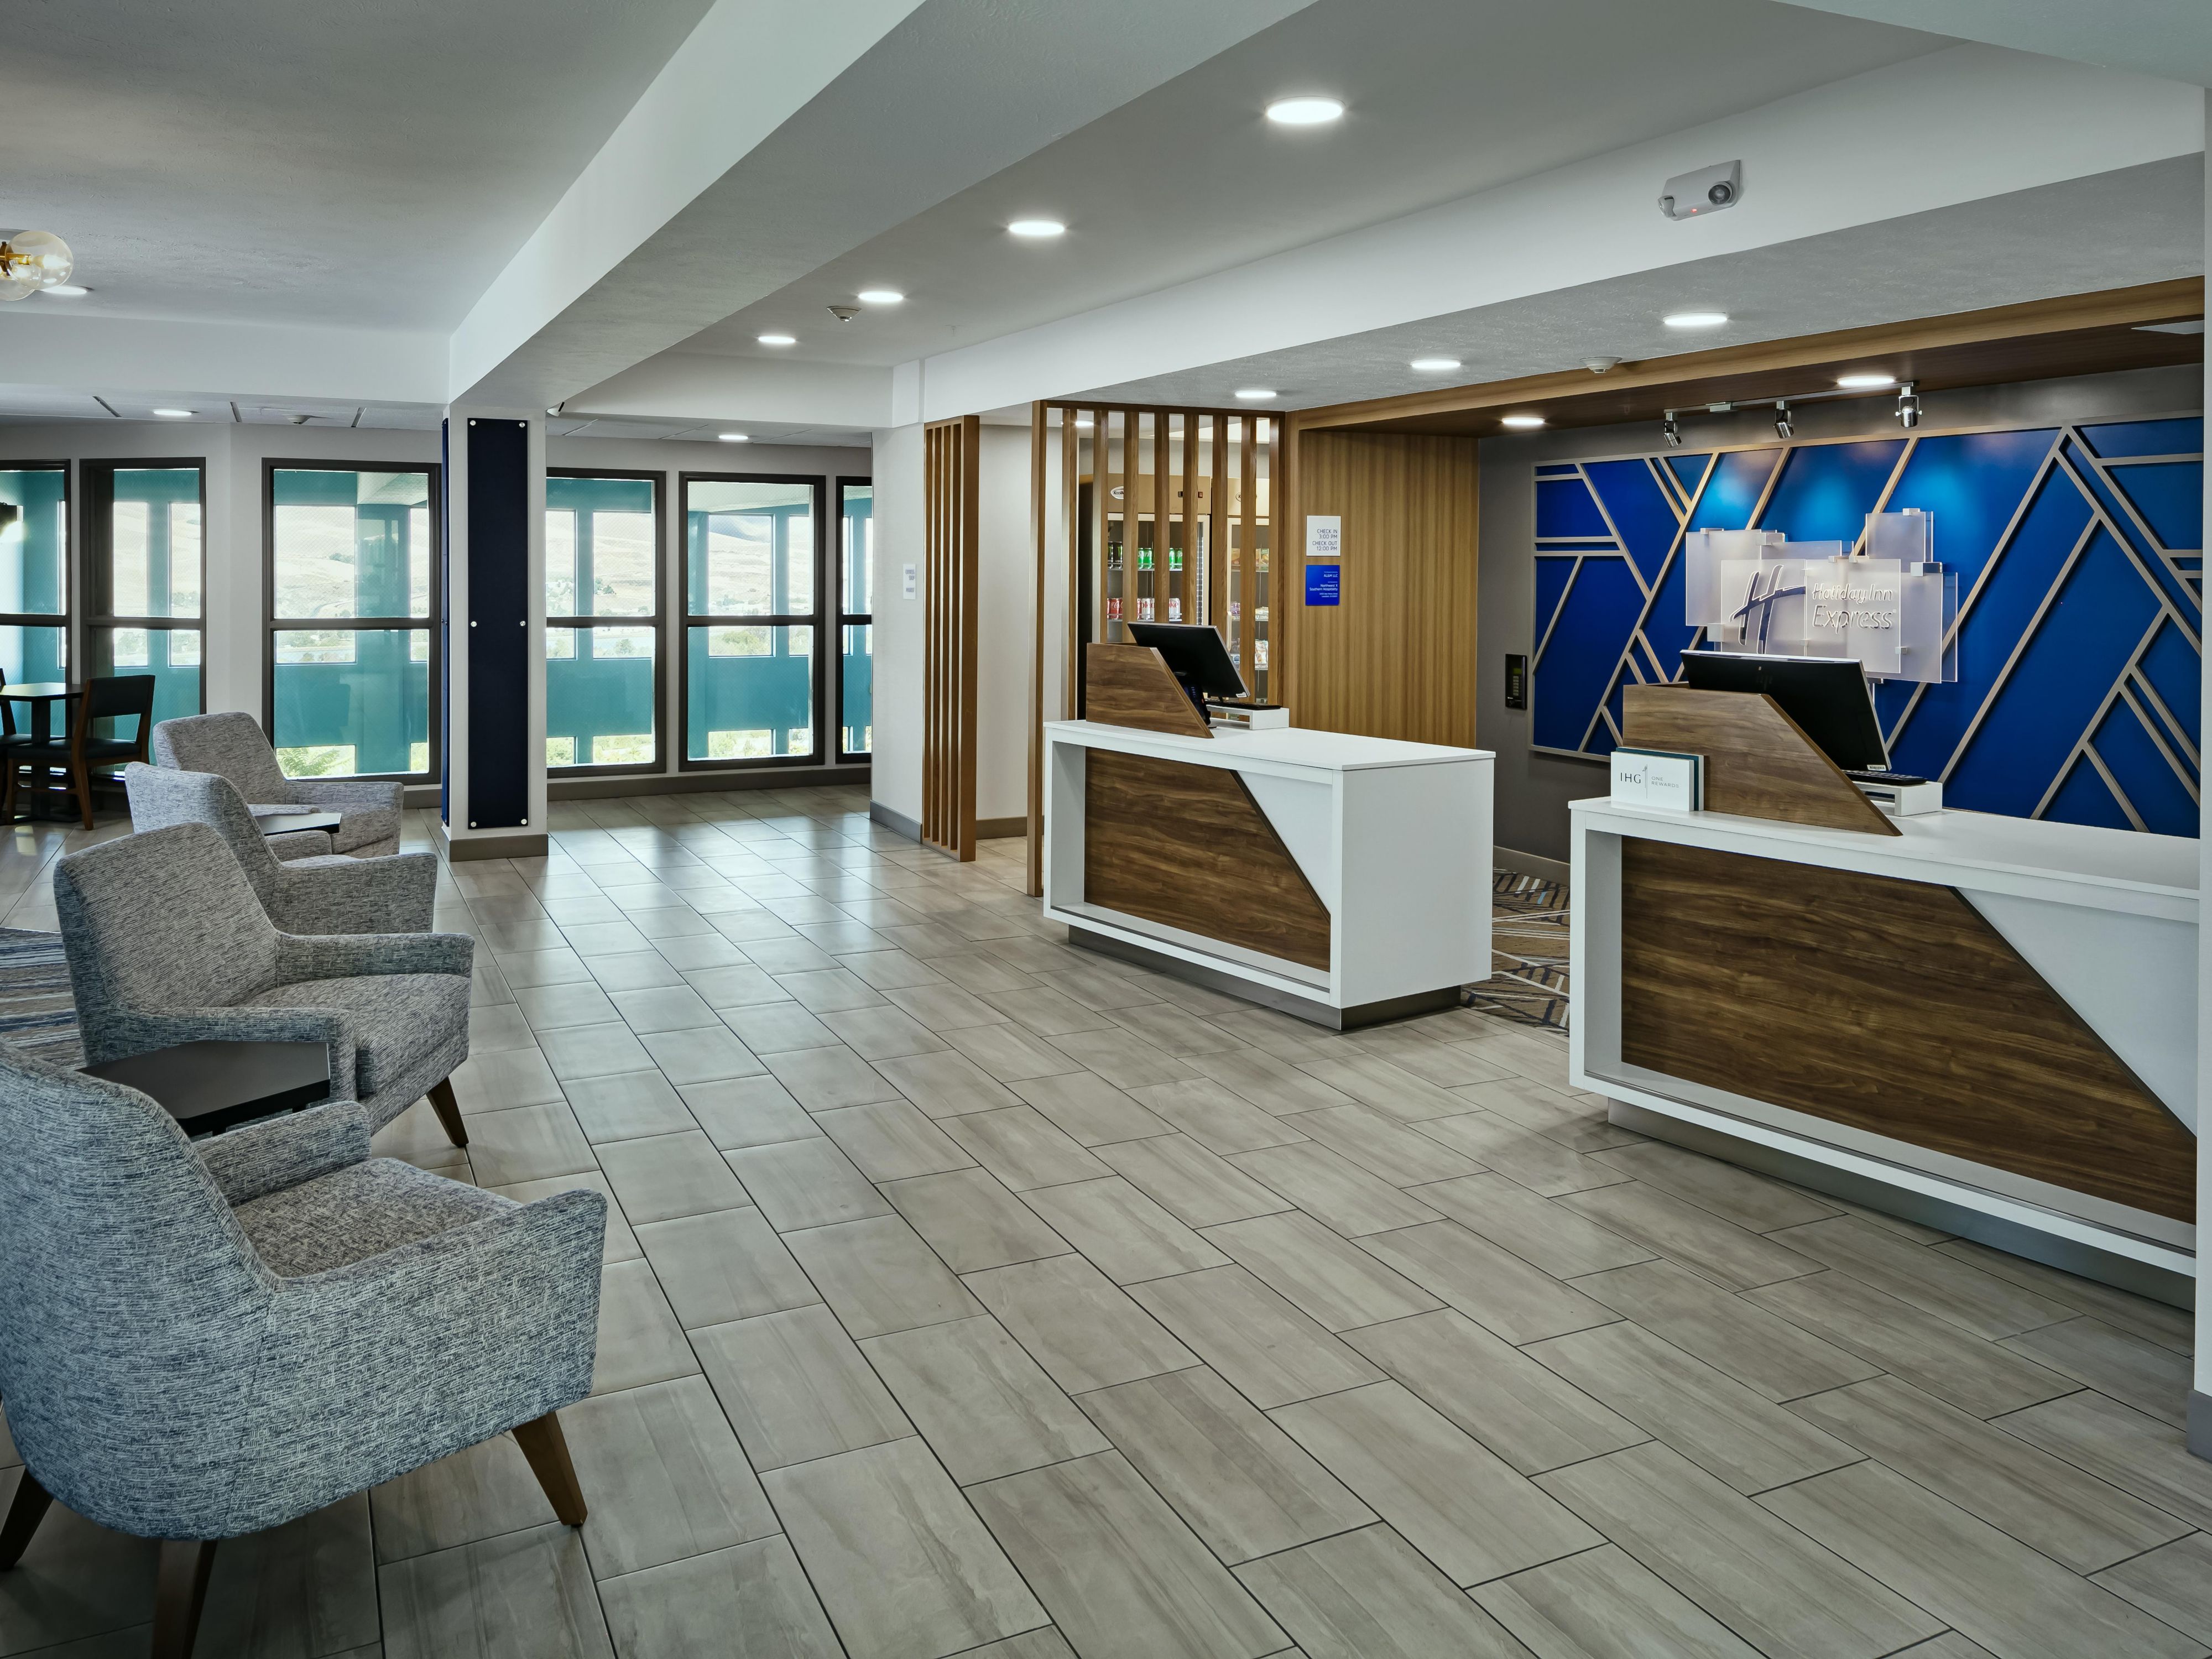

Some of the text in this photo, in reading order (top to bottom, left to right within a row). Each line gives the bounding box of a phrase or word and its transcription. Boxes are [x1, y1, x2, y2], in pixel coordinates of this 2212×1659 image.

[1812, 583, 1893, 604] Holiday Inn
[1812, 604, 1893, 634] Express
[1620, 772, 1641, 784] IHG
